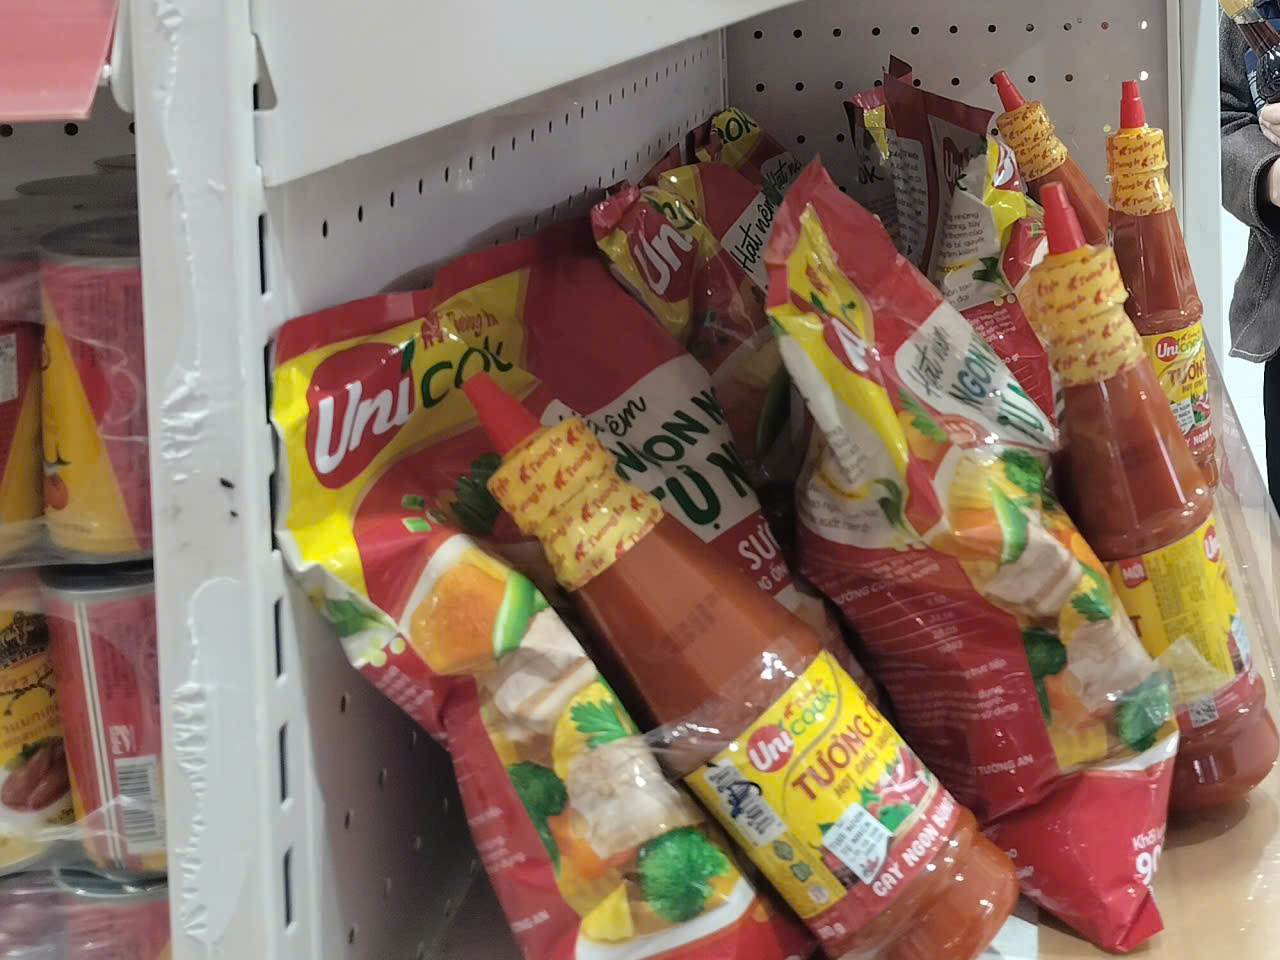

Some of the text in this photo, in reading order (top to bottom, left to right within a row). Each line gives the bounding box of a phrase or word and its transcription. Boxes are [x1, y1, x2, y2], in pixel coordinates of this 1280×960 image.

[1157, 342, 1179, 359] Uni
[315, 381, 415, 474] Uni
[750, 729, 795, 772] Uni
[903, 835, 940, 867] NGON
